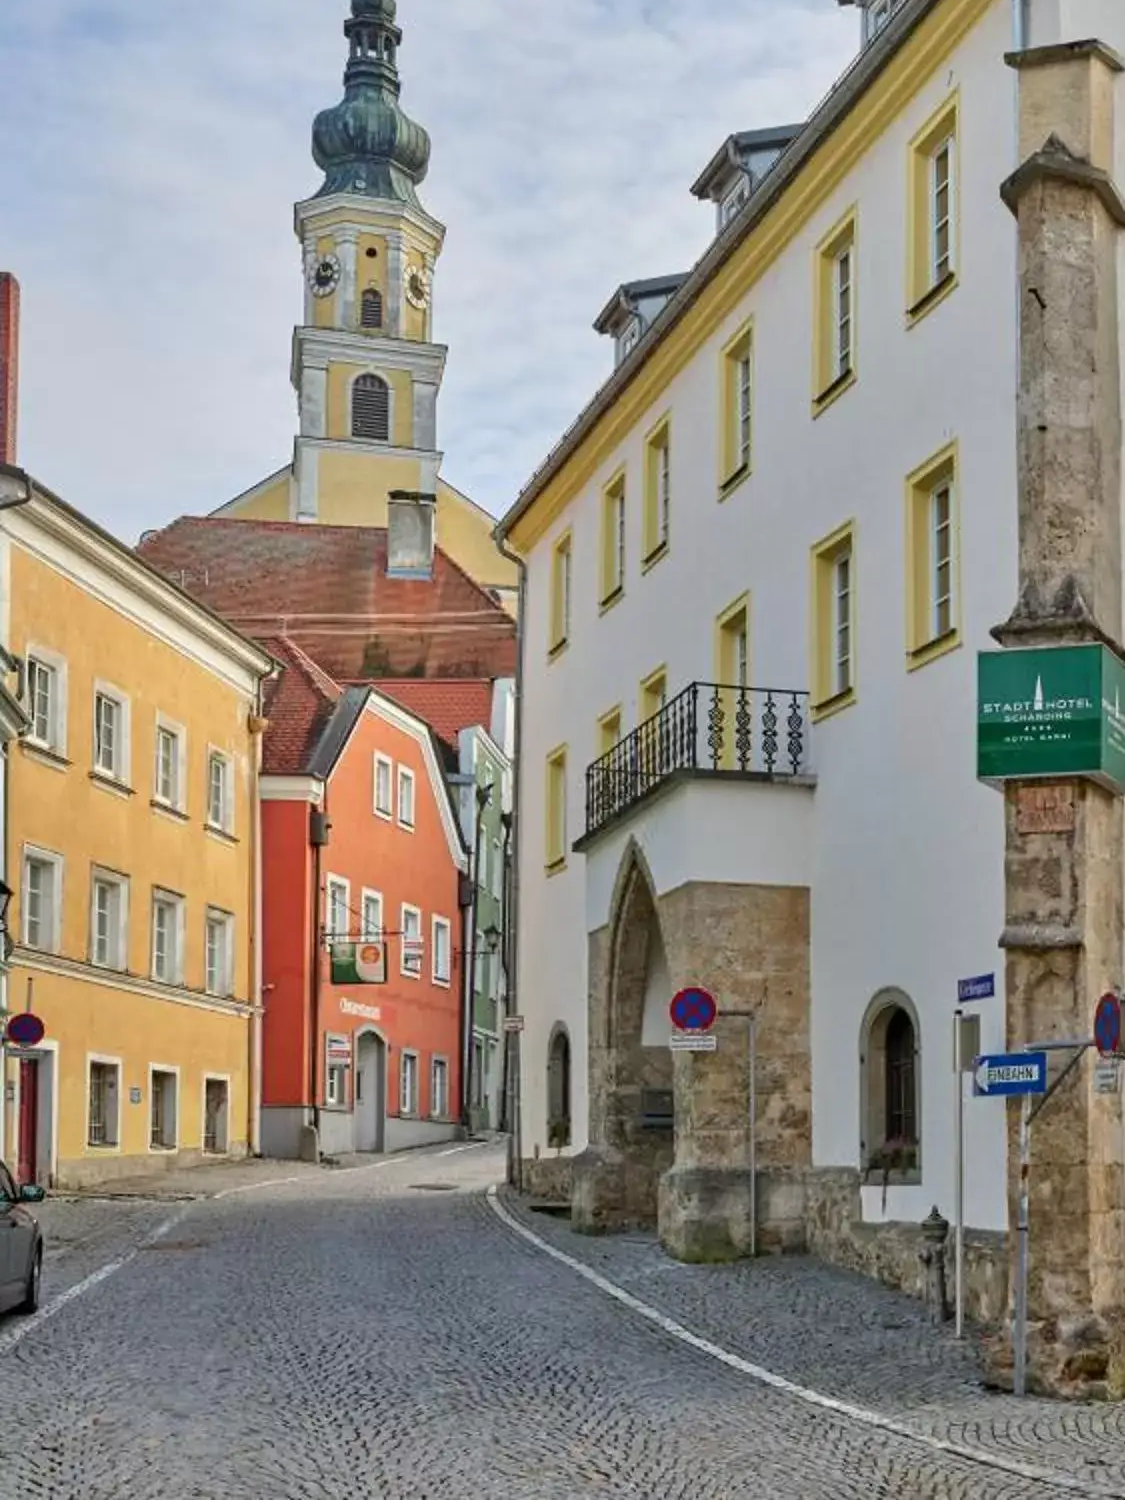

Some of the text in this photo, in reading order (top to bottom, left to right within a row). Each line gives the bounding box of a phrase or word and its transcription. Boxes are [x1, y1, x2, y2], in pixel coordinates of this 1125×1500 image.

[983, 698, 1093, 713] STADT HOTEL
[988, 1067, 1033, 1080] EINBAHN
